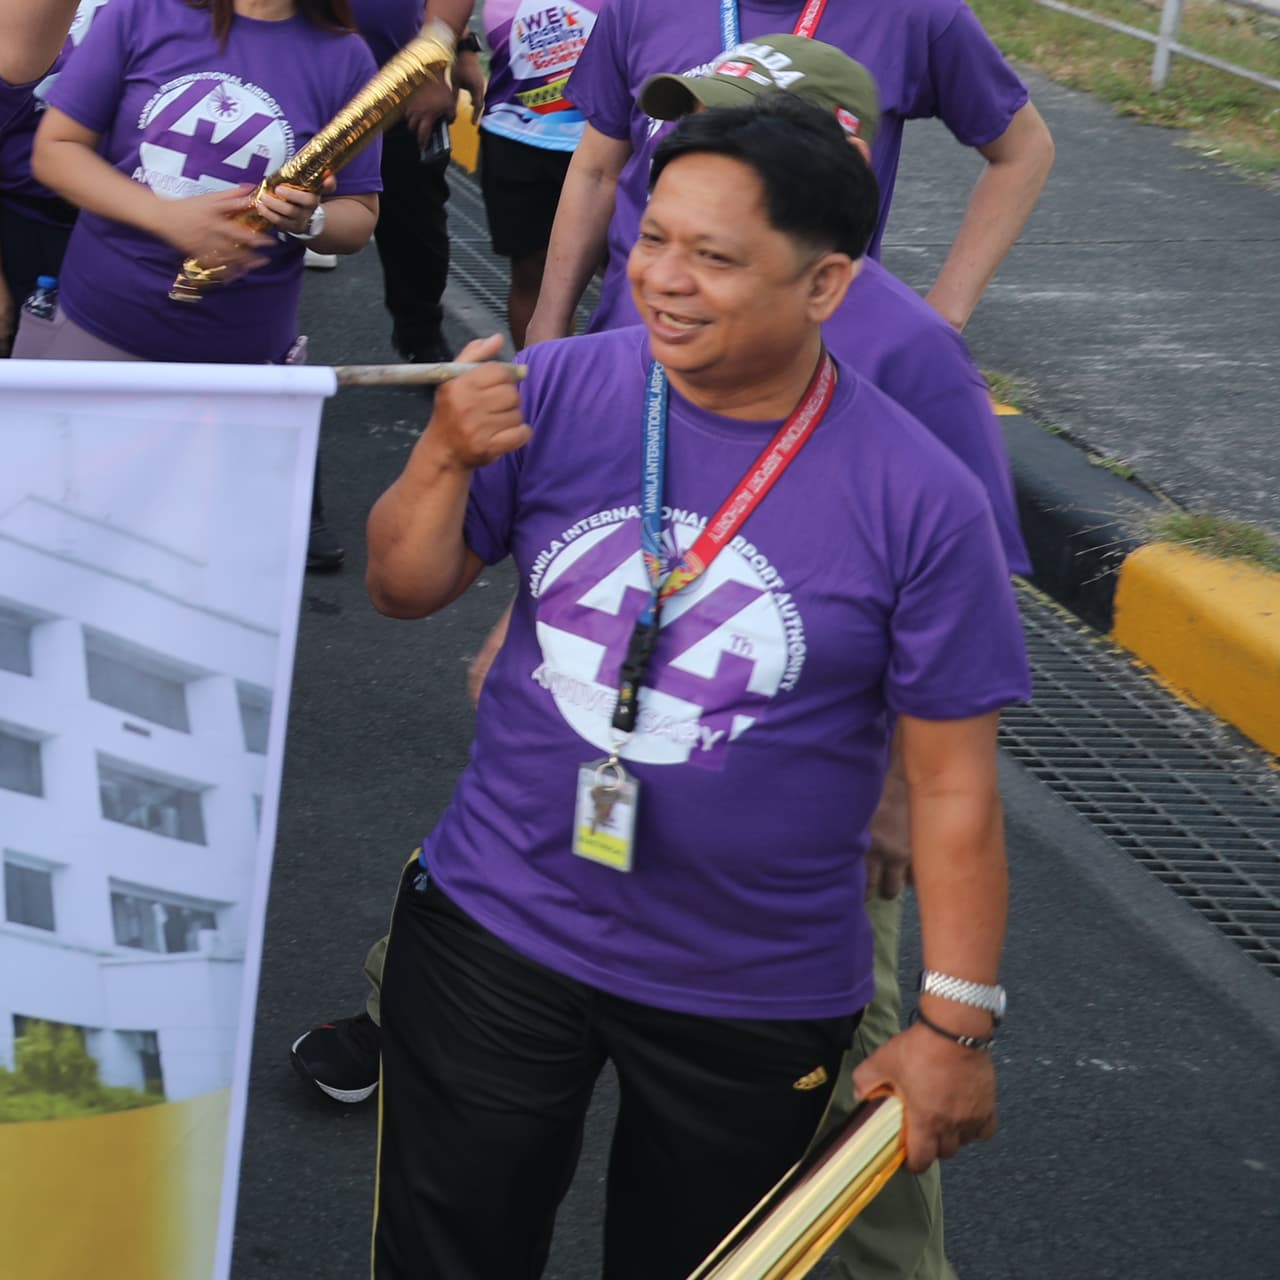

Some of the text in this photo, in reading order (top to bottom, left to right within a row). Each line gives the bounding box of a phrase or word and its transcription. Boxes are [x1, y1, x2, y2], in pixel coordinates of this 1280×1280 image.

[645, 396, 661, 474] INTERNATIONAL
[644, 474, 659, 513] MANILA
[529, 540, 565, 598] MANILA
[773, 592, 807, 691] AUTHORITY
